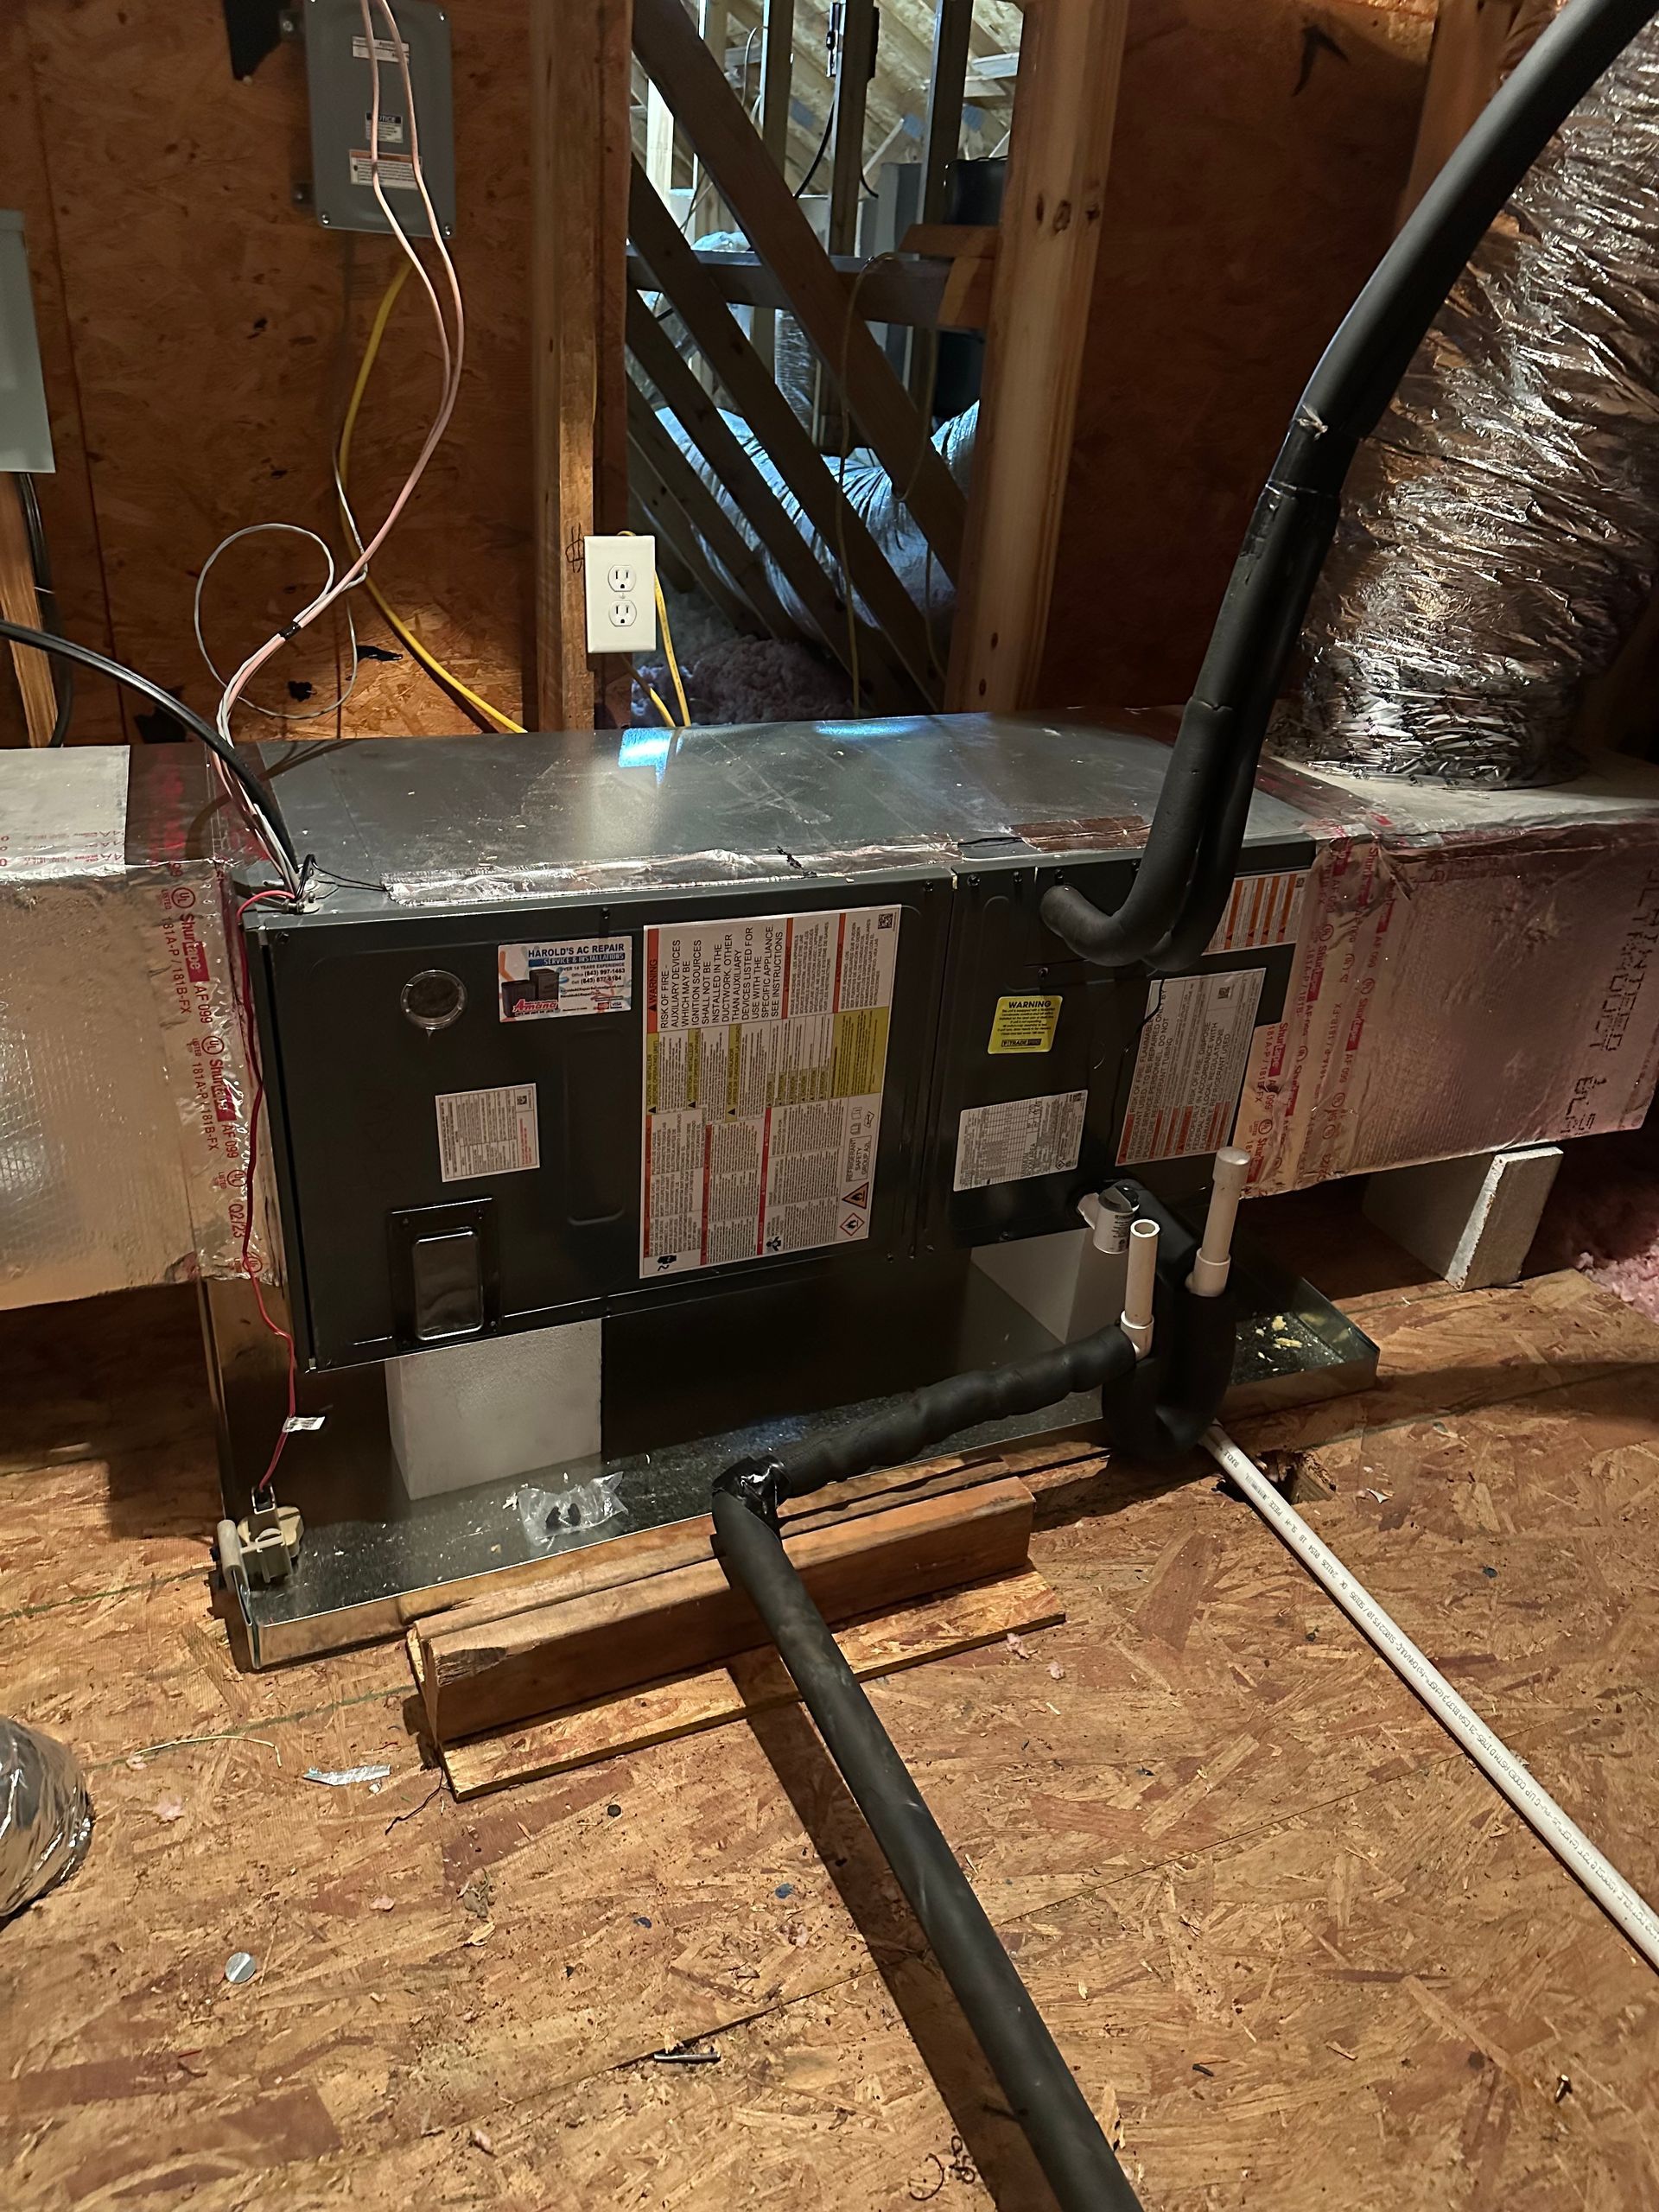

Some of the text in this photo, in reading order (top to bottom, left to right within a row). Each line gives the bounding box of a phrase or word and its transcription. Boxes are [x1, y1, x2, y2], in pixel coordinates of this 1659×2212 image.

[529, 947, 574, 957] HAROLD'S
[592, 944, 624, 953] REPAIR
[544, 957, 570, 966] SERVICE
[579, 953, 623, 963] INSTALLATIONS
[161, 916, 181, 957] 181A-P
[171, 967, 193, 1014] 181B-FX
[178, 912, 214, 1024] Shurtape AF 099
[683, 961, 690, 973] BE
[703, 961, 711, 973] BE
[714, 964, 721, 973] IN
[721, 934, 733, 1022] DUCTWORK, OTHER
[733, 950, 742, 995] AUXILIARY
[741, 927, 753, 1020] DEVICES LISTED FOR
[753, 957, 762, 973] THE
[771, 931, 783, 1017] SEE INSTRUCTIONS
[649, 959, 658, 1003] WARNING
[691, 939, 702, 1026] IGNITION SOURCES
[512, 995, 557, 1013] Amana
[661, 993, 669, 1006] OF
[671, 982, 679, 1027] AUXILIARY
[712, 976, 721, 1023] INSTALLED
[761, 978, 771, 1018] SPECIFIC
[1160, 1017, 1170, 1033] NOT
[1147, 1024, 1160, 1061] REPAIRED
[1158, 1034, 1166, 1046] DO
[1262, 1026, 1275, 1057] 181A-P
[1145, 1063, 1153, 1073] BE
[1188, 1022, 1211, 1104] RISK OF DISPOSE
[1195, 1022, 1218, 1103] IN ACCORDANCE WITH
[1133, 1084, 1141, 1095] OF
[1142, 1075, 1151, 1084] TO
[1209, 1056, 1226, 1106] REFRIGERANT
[1129, 1096, 1139, 1113] RISK
[1202, 1082, 1213, 1105] LOCAL
[1264, 1094, 1273, 1109] 099
[1141, 1096, 1154, 1127] SERVICE
[1142, 1119, 1156, 1158] PUNCTURE
[1151, 1067, 1167, 1117] REFRIGERANT
[1199, 1106, 1208, 1116] OR
[200, 1108, 219, 1152] 181B-FX
[220, 1123, 234, 1137] AF
[1135, 1128, 1147, 1158] TRAINED
[1192, 1118, 1205, 1150] FEDERAL
[224, 1138, 239, 1159] 099
[227, 1202, 248, 1239] Q2/23
[1268, 1500, 1283, 1516] PIECE
[1457, 1712, 1471, 1727] CSA
[1493, 1752, 1511, 1772] ASTM
